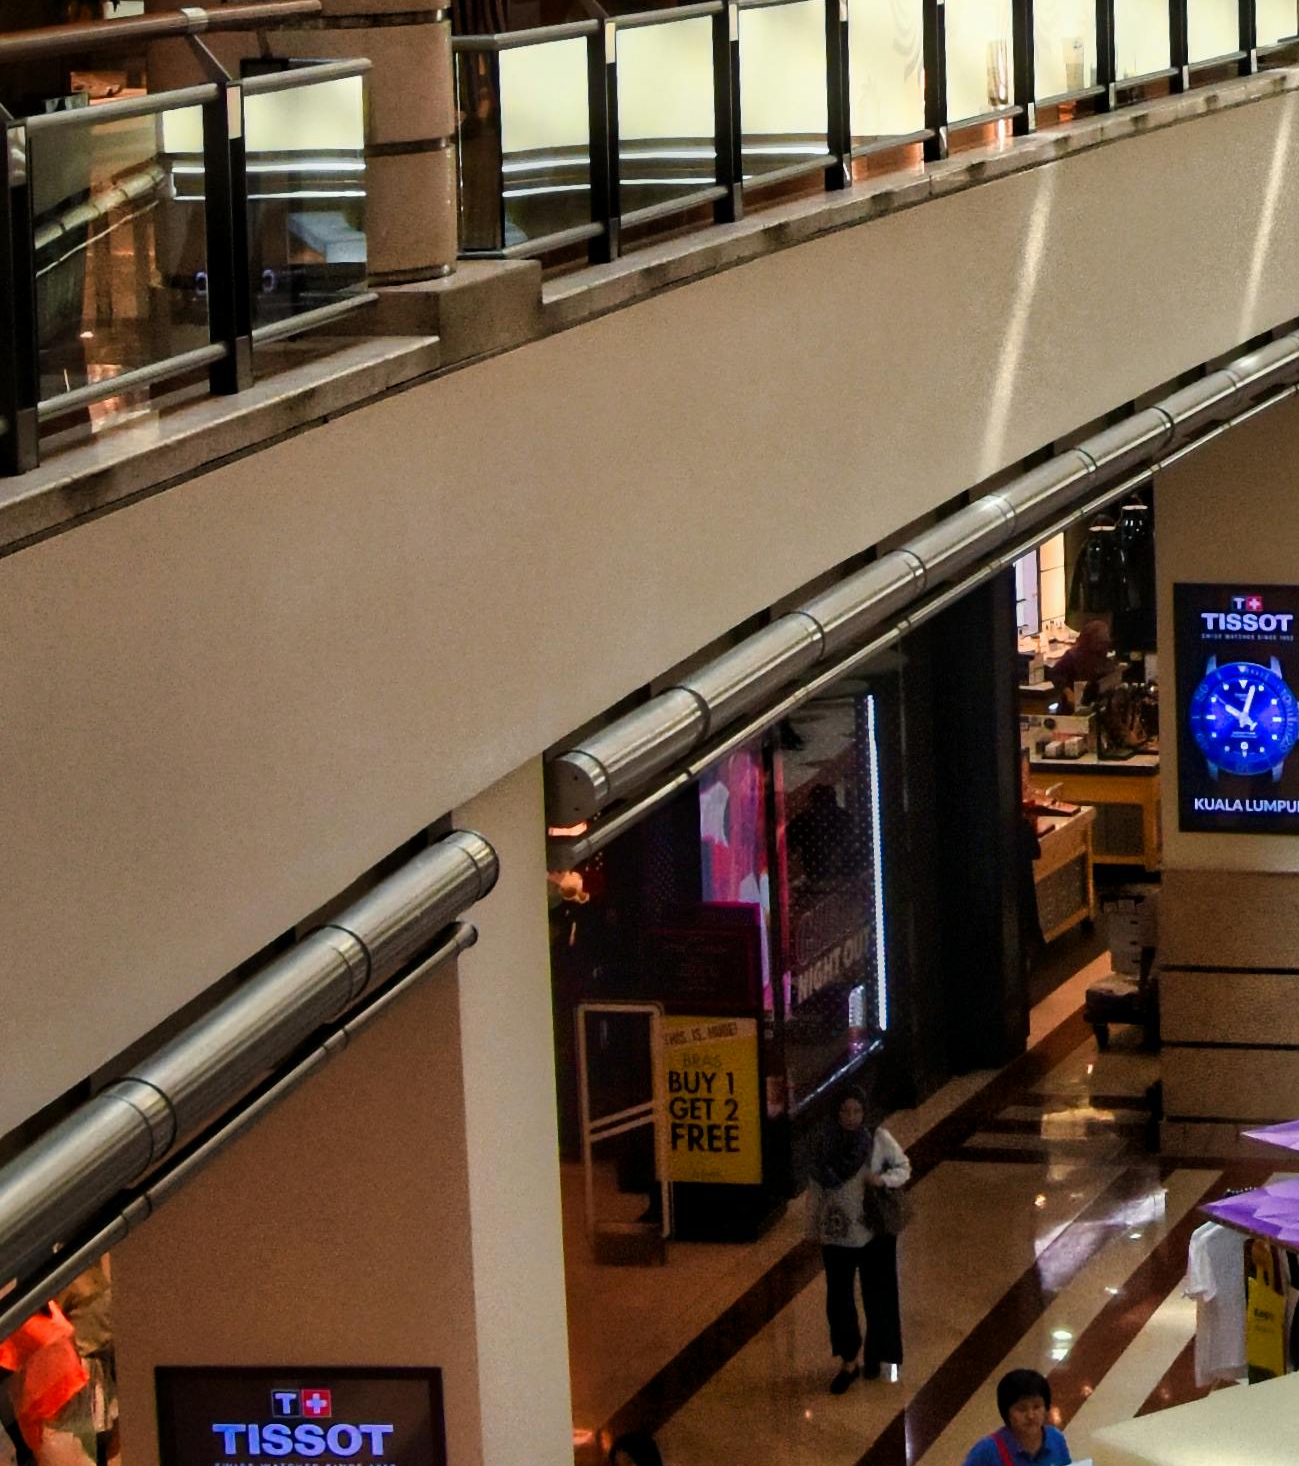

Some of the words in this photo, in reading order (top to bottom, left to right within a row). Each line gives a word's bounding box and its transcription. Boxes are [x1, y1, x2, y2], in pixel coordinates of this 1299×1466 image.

[1200, 612, 1294, 632] TISSOT
[1194, 797, 1243, 812] KUALA
[668, 1071, 715, 1095] BUY
[726, 1072, 735, 1094] 1
[669, 1097, 713, 1121] GET
[724, 1098, 739, 1122] 2
[671, 1123, 741, 1153] FREE
[275, 1392, 297, 1415] T
[212, 1423, 394, 1457] TISSOT
